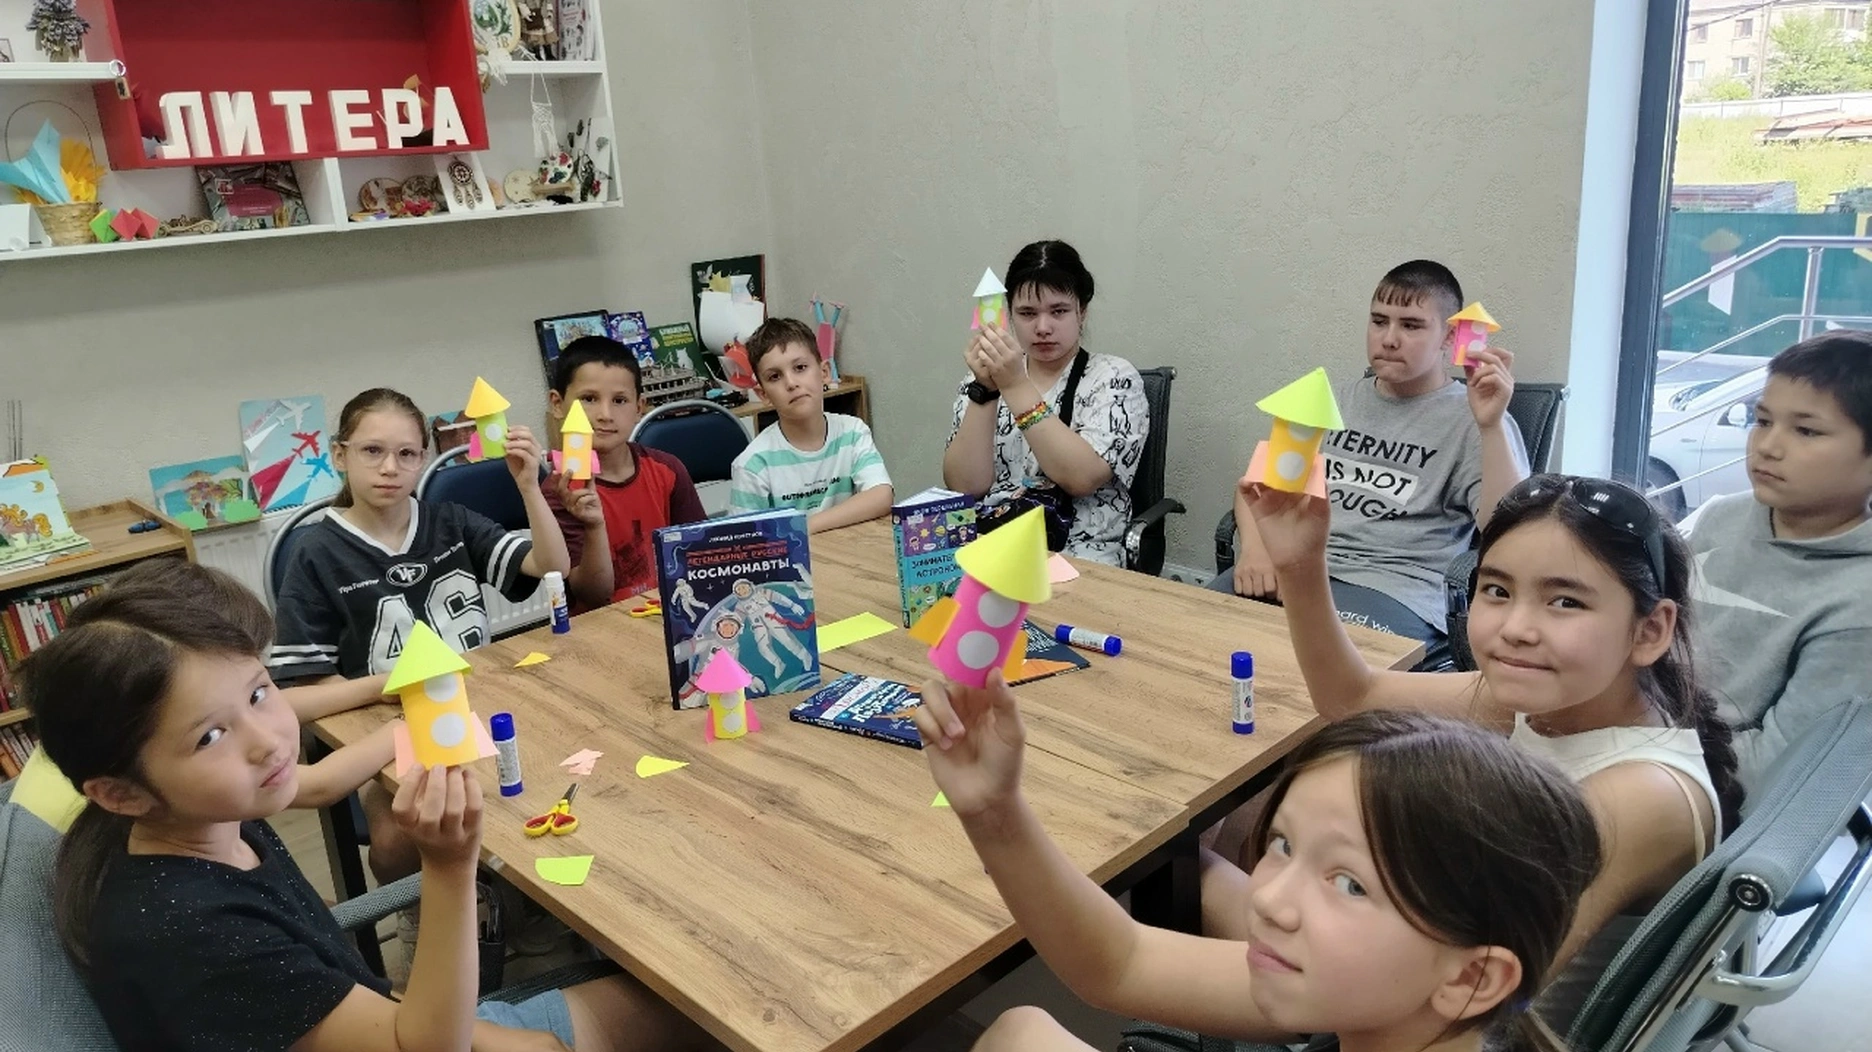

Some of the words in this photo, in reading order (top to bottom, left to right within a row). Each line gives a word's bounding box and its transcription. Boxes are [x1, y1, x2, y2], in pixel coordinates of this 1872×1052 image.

[157, 86, 470, 160] ЛИТЕРА
[1327, 429, 1438, 469] TERNITY
[1325, 458, 1344, 480] IS
[1351, 466, 1412, 496] NOT
[1330, 488, 1408, 521] OUGH
[687, 553, 748, 566] ЛЕГЕНДАРНЫЕ
[751, 545, 788, 559] РУССКИЕ
[911, 553, 955, 570] ЗАНИМАТЕ
[398, 566, 416, 582] VF
[687, 558, 790, 581] КОСМОНАВТЫ
[916, 563, 962, 578] АСТРОНОМ
